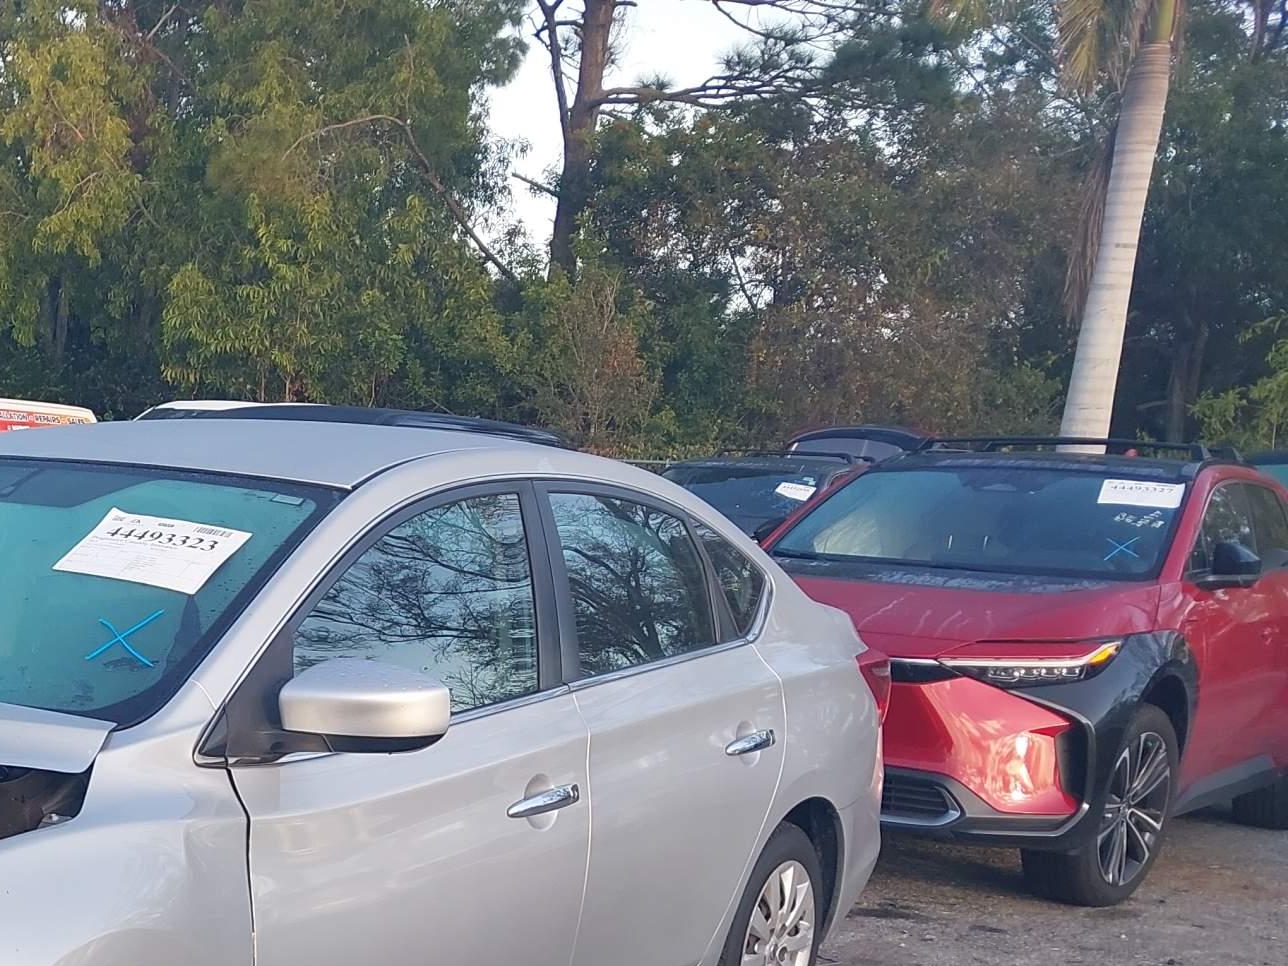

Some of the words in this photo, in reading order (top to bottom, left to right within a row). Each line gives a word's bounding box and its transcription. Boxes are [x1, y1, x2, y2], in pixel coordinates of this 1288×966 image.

[34, 414, 60, 424] REPAIRS
[1111, 484, 1174, 493] 44493327
[107, 526, 219, 552] 44493323
